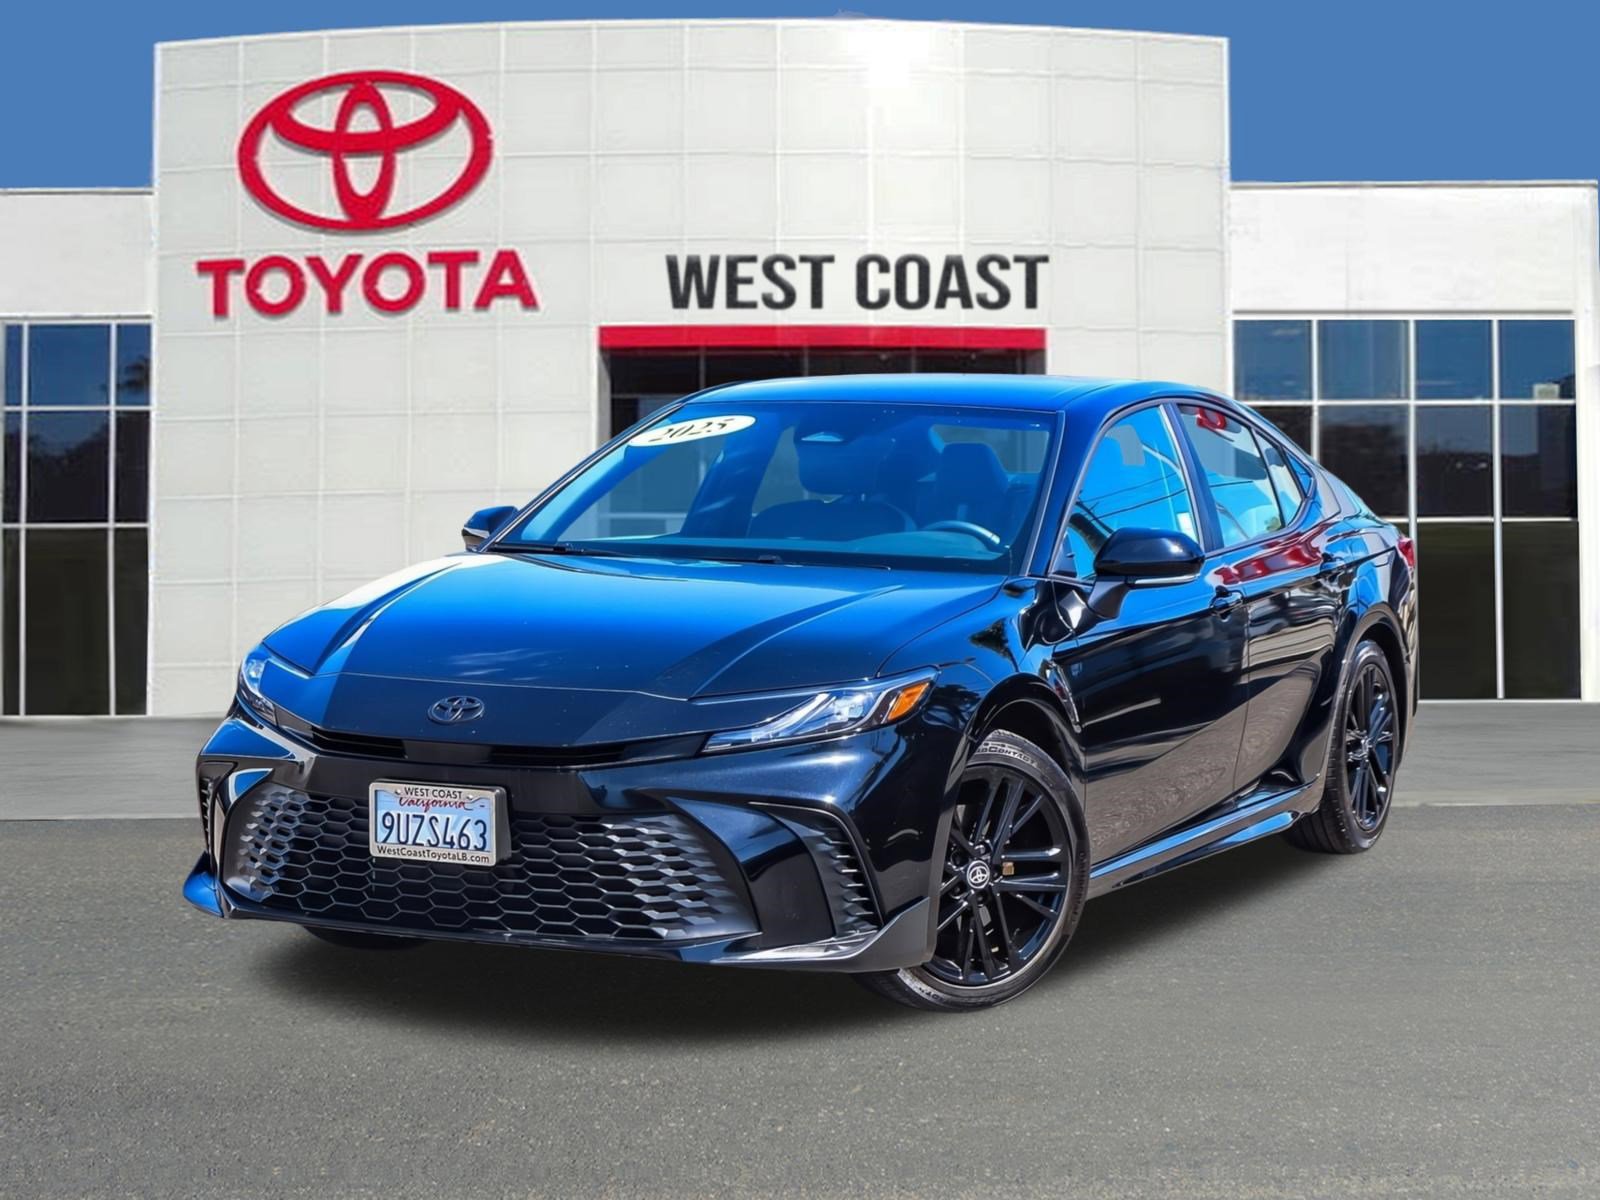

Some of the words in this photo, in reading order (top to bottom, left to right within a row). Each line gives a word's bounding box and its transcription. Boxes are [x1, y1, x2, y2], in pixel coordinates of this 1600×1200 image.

[196, 249, 539, 318] TOYOTA
[665, 254, 835, 310] WEST
[855, 254, 1049, 310] COAST
[647, 417, 736, 443] 2025
[404, 786, 430, 798] WEST
[431, 788, 463, 800] COAST
[381, 811, 488, 852] 9UZS463
[376, 845, 490, 864] WestCoastToyotaLB.com
